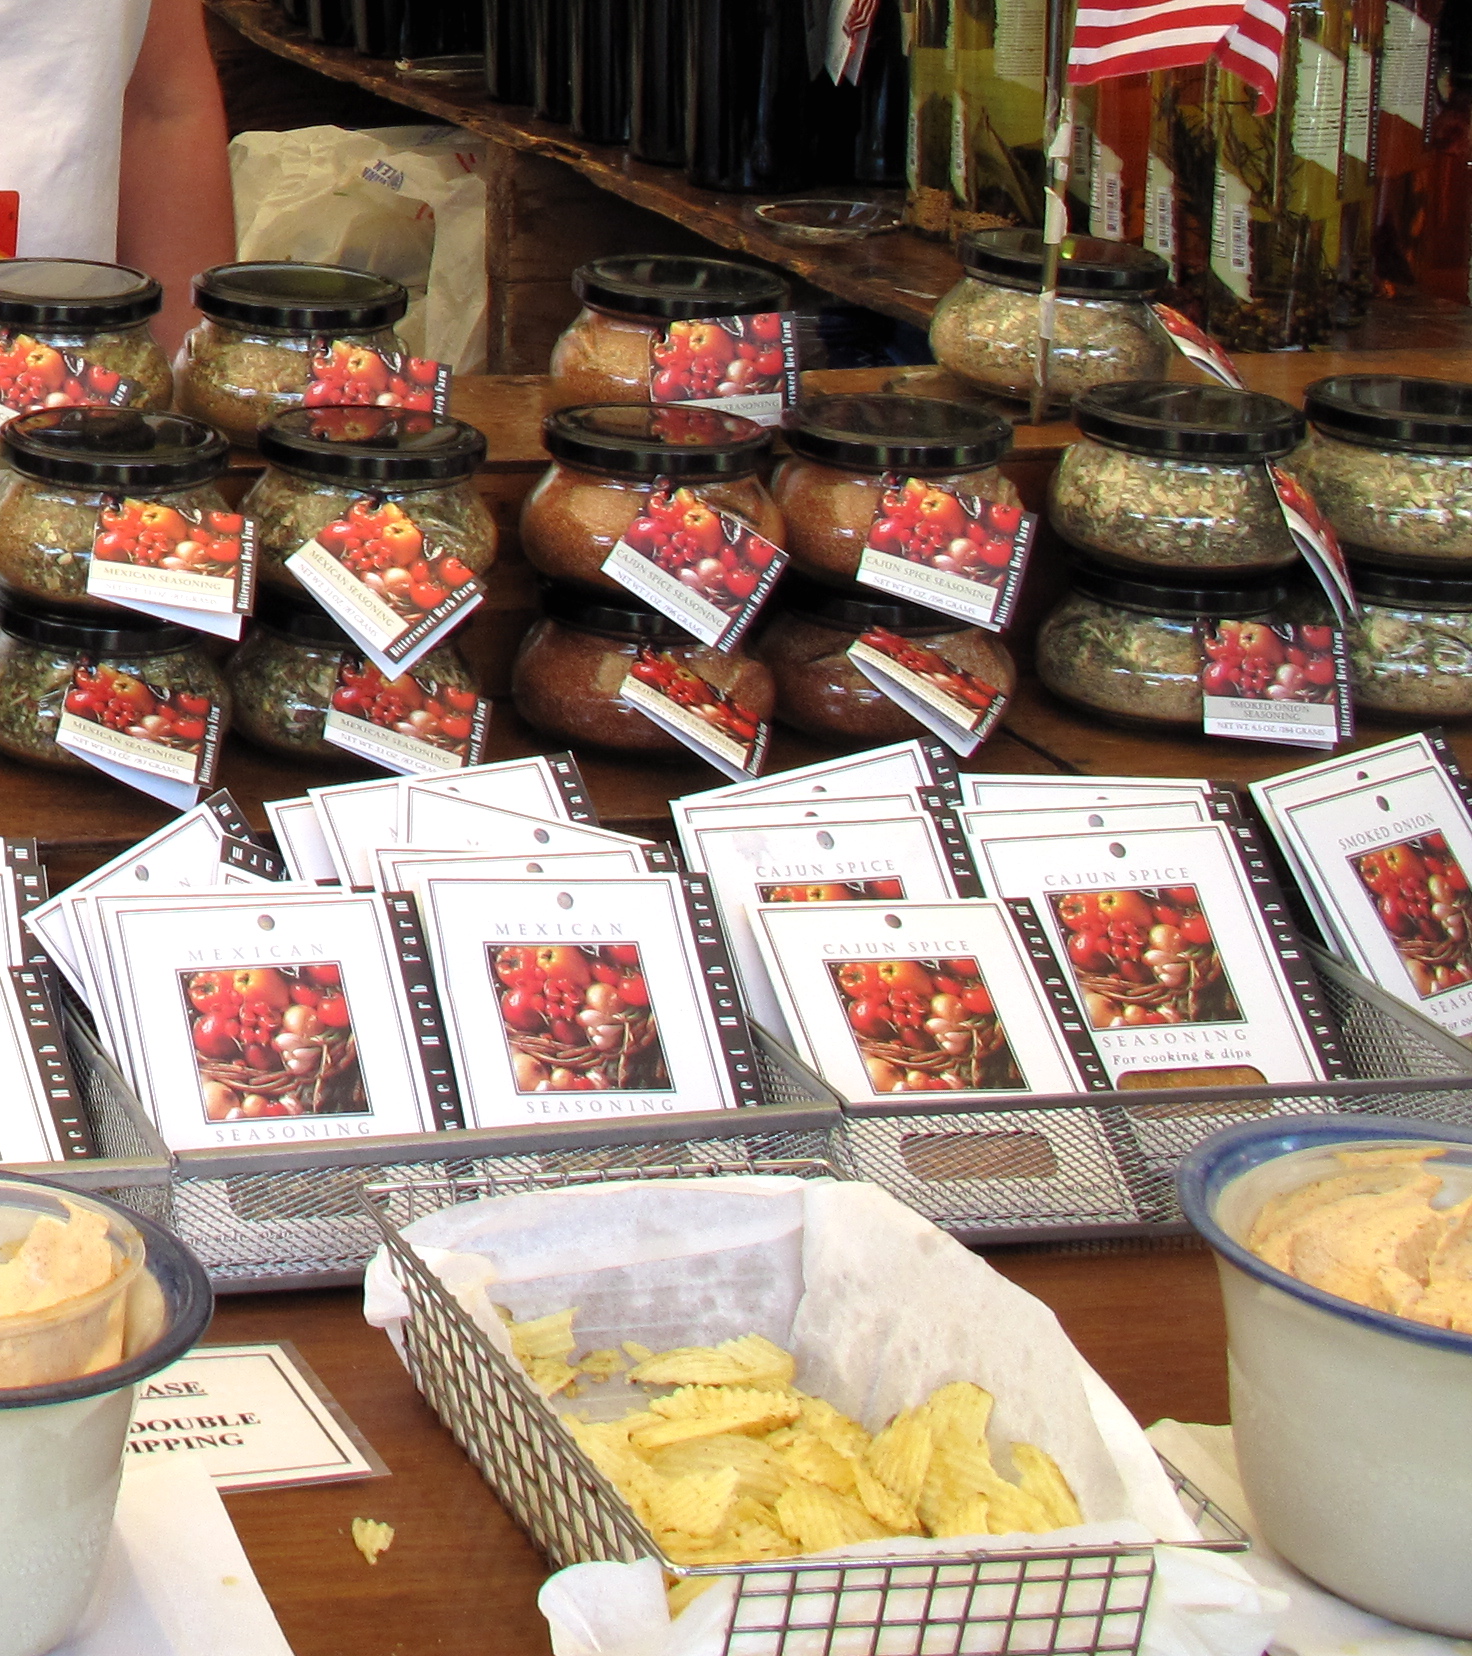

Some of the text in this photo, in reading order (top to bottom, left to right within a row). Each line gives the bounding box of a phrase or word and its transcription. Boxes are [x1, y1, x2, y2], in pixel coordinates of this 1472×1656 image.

[865, 556, 992, 602] CAJUN SPICE SEASONING
[1338, 812, 1436, 851] SMOKED ONION
[1044, 867, 1191, 887] CAJUN SPICE
[495, 922, 624, 937] MEXICAN
[1102, 1029, 1248, 1049] SEASONING
[1112, 1047, 1251, 1066] For cooking & dips
[526, 1099, 675, 1115] SEASONING
[130, 1412, 261, 1434] DOUBLE
[125, 1432, 245, 1454] IPPING
